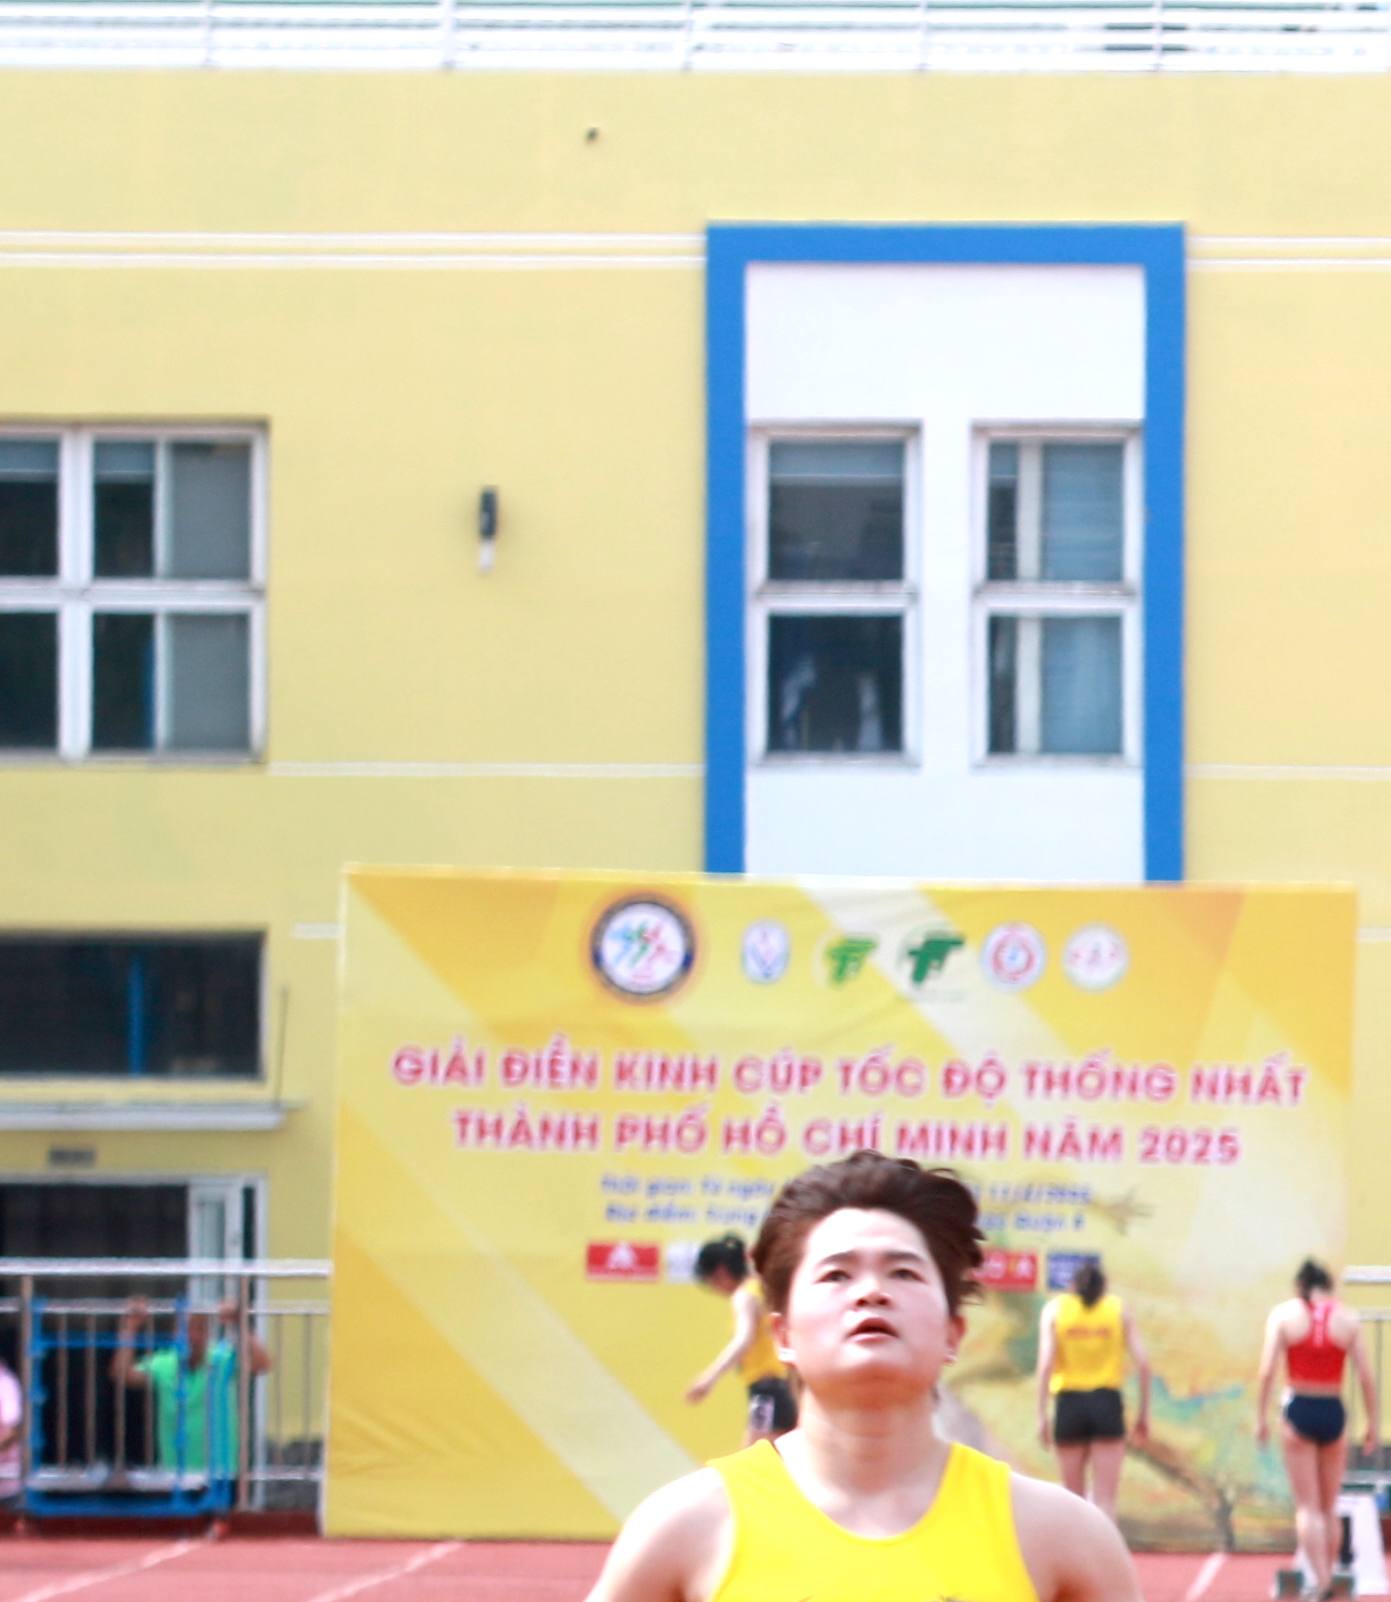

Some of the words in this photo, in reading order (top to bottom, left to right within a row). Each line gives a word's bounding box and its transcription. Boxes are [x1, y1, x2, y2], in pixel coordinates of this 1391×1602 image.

[393, 1036, 485, 1088] GIẢI
[615, 1051, 717, 1091] KINH
[734, 1047, 823, 1094] CÚP
[838, 1045, 925, 1097] TỐC
[942, 1051, 1006, 1108] ĐỘ
[1023, 1049, 1176, 1101] THỐNG
[1190, 1053, 1307, 1105] NHẤT
[454, 1102, 598, 1152] THÀNH
[615, 1102, 711, 1154] PHỐ
[803, 1112, 884, 1155] CHÍ
[898, 1119, 1008, 1160] MINH
[1023, 1117, 1123, 1161] NĂM
[1139, 1127, 1240, 1164] 2025
